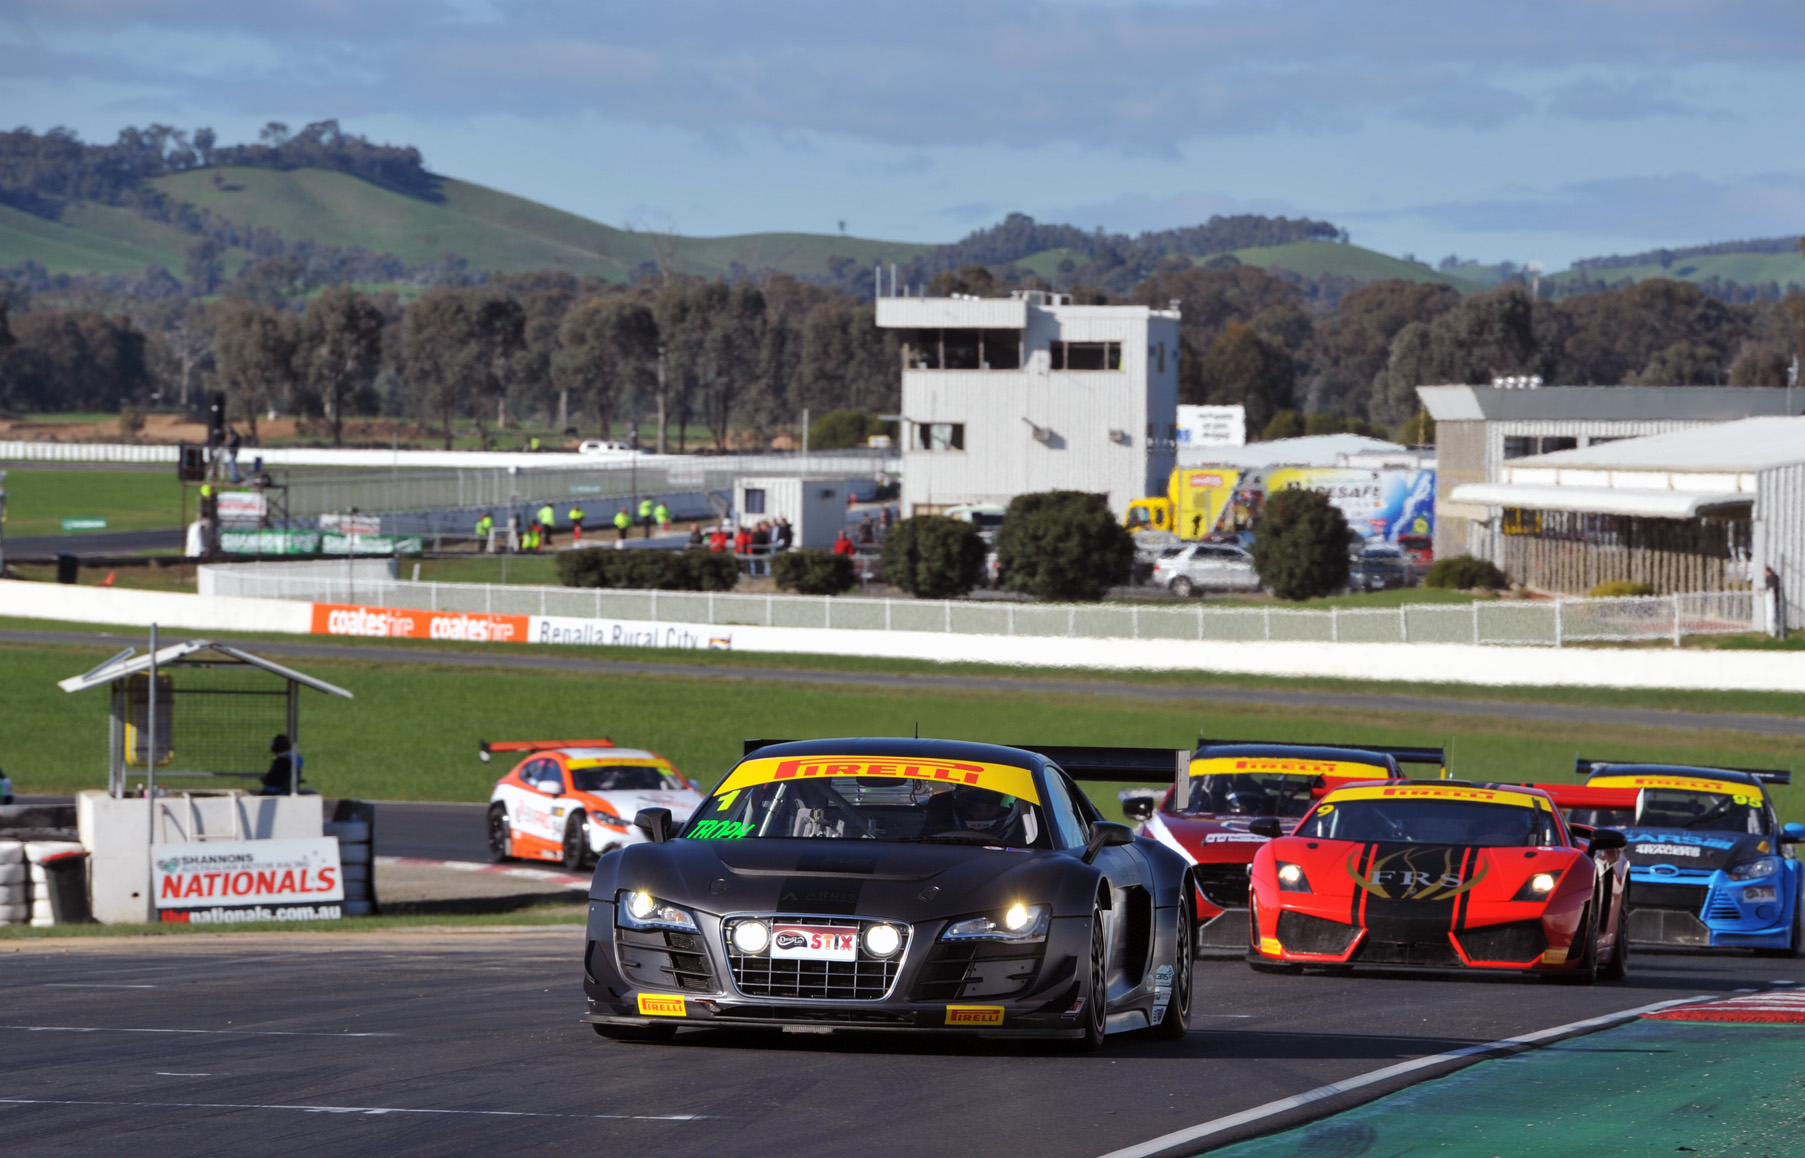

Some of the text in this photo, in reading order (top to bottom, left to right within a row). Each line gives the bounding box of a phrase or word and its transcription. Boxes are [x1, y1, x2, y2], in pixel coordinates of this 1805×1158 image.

[540, 620, 699, 649] Benalla Rural City
[773, 757, 985, 785] PIRELLI
[1235, 761, 1337, 773] PIRELLI
[1635, 778, 1723, 791] PIRELLI
[716, 789, 742, 812] 1
[1383, 787, 1497, 800] PIRELLI
[1316, 803, 1336, 818] 9
[181, 853, 254, 865] SHANNONS
[161, 867, 336, 899] NATIONALS
[1369, 869, 1464, 888] FRS
[810, 933, 854, 951] STIX
[641, 998, 684, 1013] PIRELLI
[950, 1009, 1000, 1023] PIRELLI
